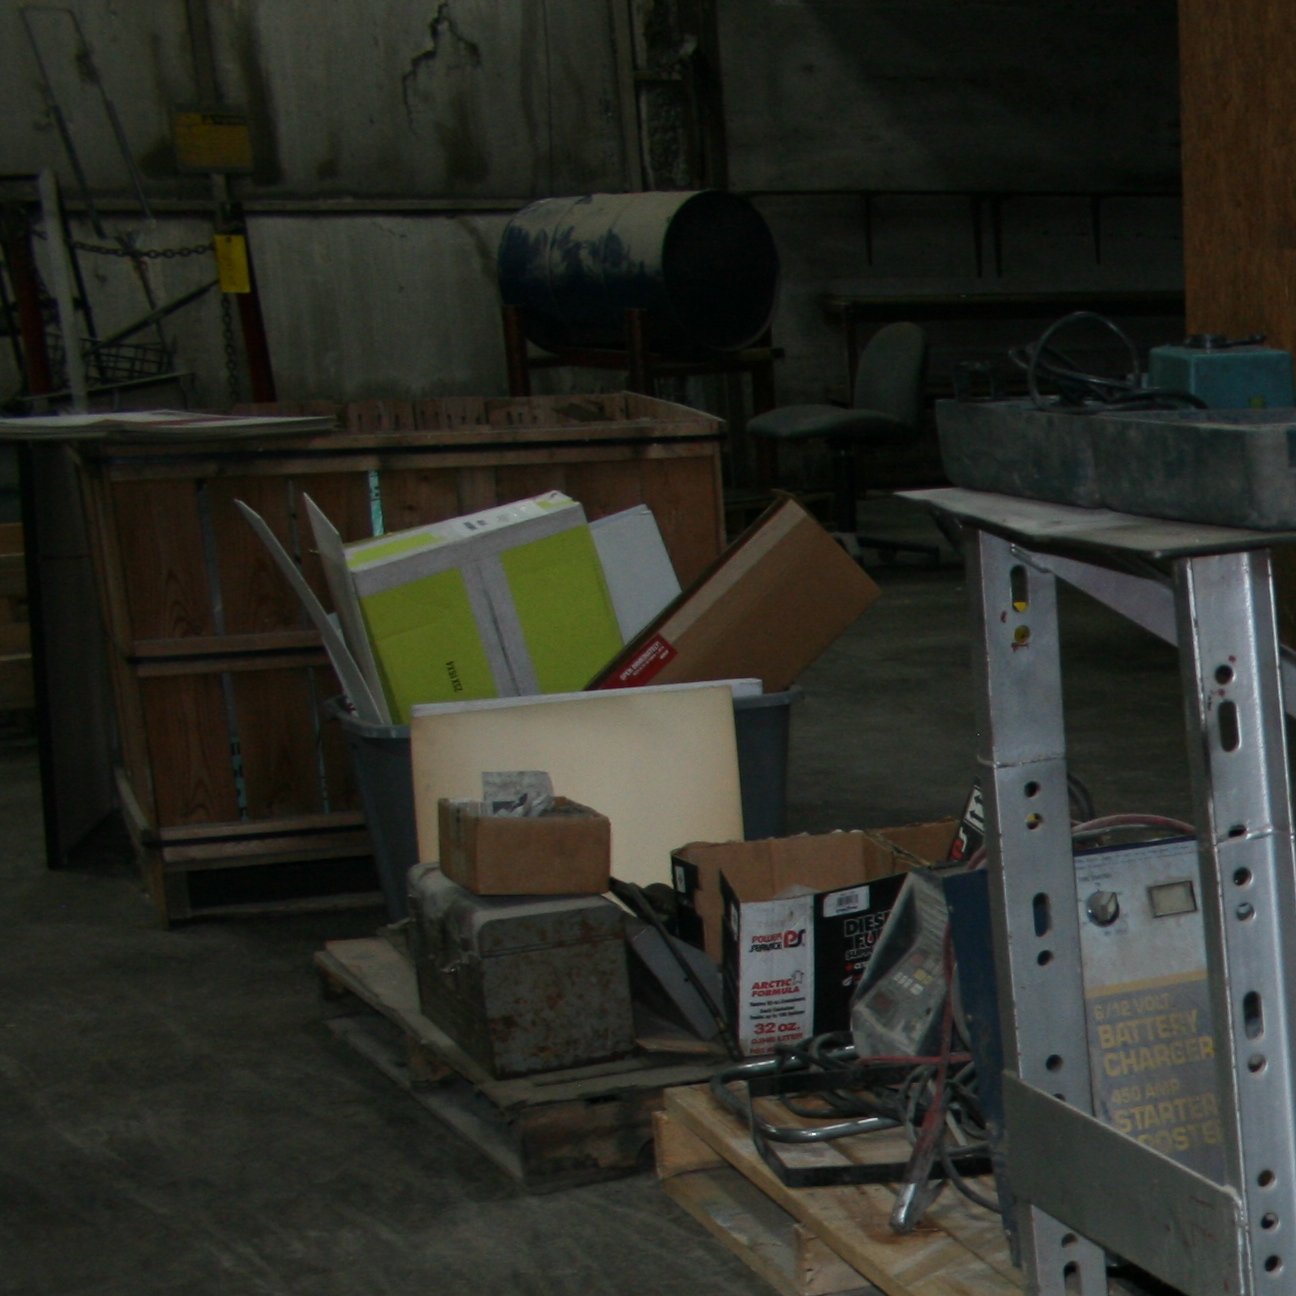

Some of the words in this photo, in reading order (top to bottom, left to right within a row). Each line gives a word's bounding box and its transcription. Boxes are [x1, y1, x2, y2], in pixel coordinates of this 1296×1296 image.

[845, 912, 888, 937] DIES
[752, 978, 793, 991] ARCTIC
[752, 986, 800, 998] FORMULA
[754, 1023, 776, 1035] 32
[1097, 1009, 1199, 1049] BATTERY
[1103, 1035, 1216, 1077] CHARGER
[1114, 1092, 1220, 1133] STARTER
